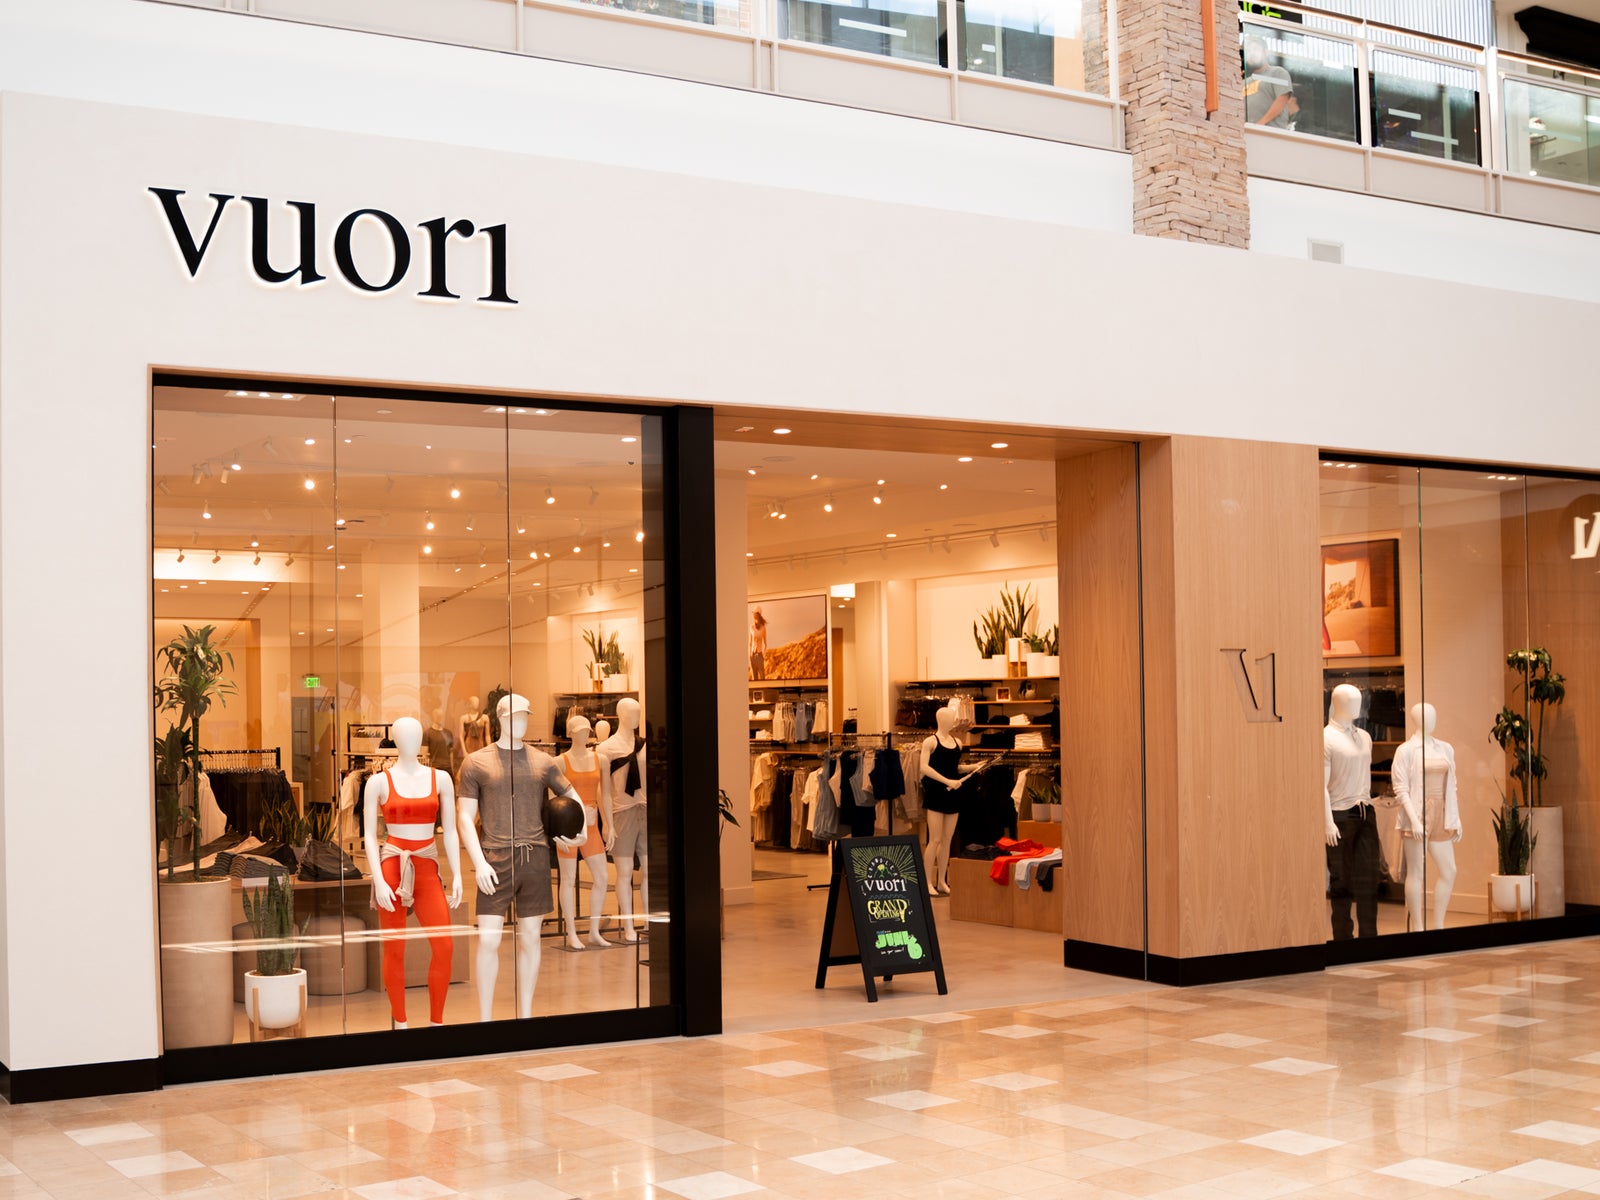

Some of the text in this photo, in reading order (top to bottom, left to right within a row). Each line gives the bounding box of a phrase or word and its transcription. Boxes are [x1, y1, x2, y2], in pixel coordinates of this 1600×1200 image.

[147, 186, 519, 304] vuori
[864, 878, 907, 892] vuori
[867, 899, 908, 916] GRAND
